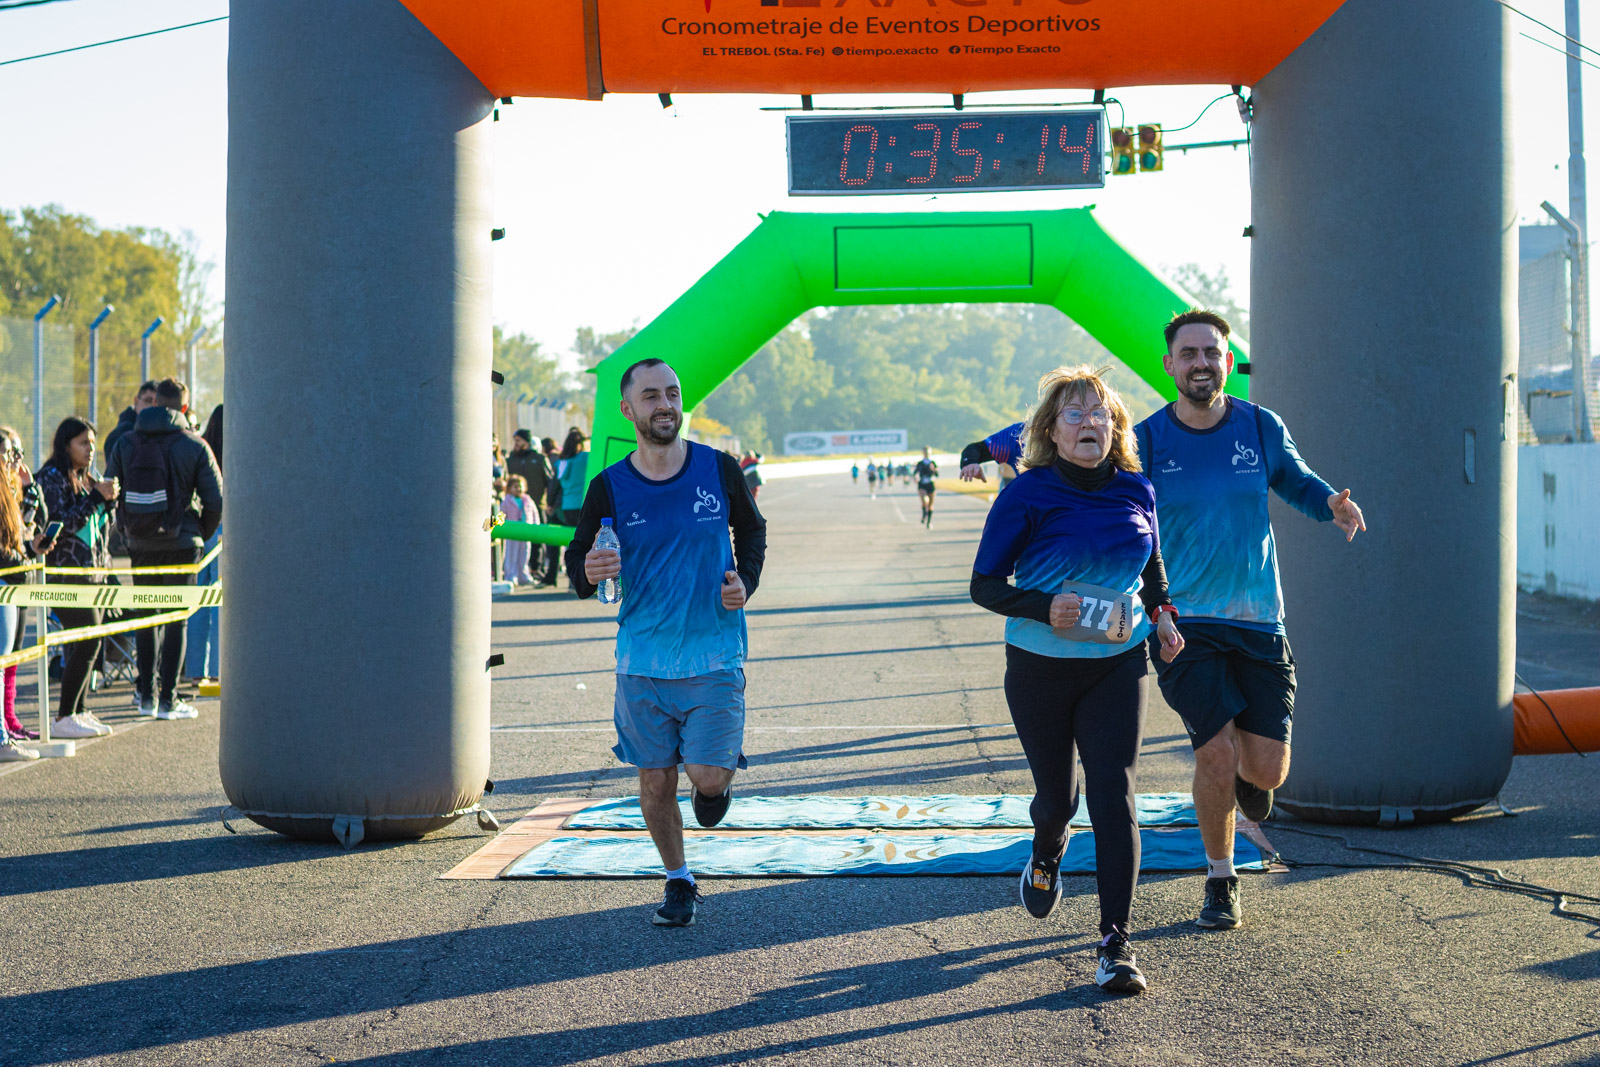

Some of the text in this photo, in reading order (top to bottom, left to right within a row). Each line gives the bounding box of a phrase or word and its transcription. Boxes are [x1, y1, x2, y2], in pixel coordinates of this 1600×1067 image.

[661, 14, 1101, 39] Cronometraje de Eventos Deportivos
[702, 46, 825, 57] EL TREBOL (Sta. Fe)
[846, 46, 939, 58] tiempo.exacto
[963, 44, 1061, 56] Tiempo Exacto
[29, 591, 78, 602] PRECAUCION
[132, 594, 183, 604] PRECAUCION
[1080, 596, 1114, 631] 77
[1116, 602, 1127, 638] EXACTO
